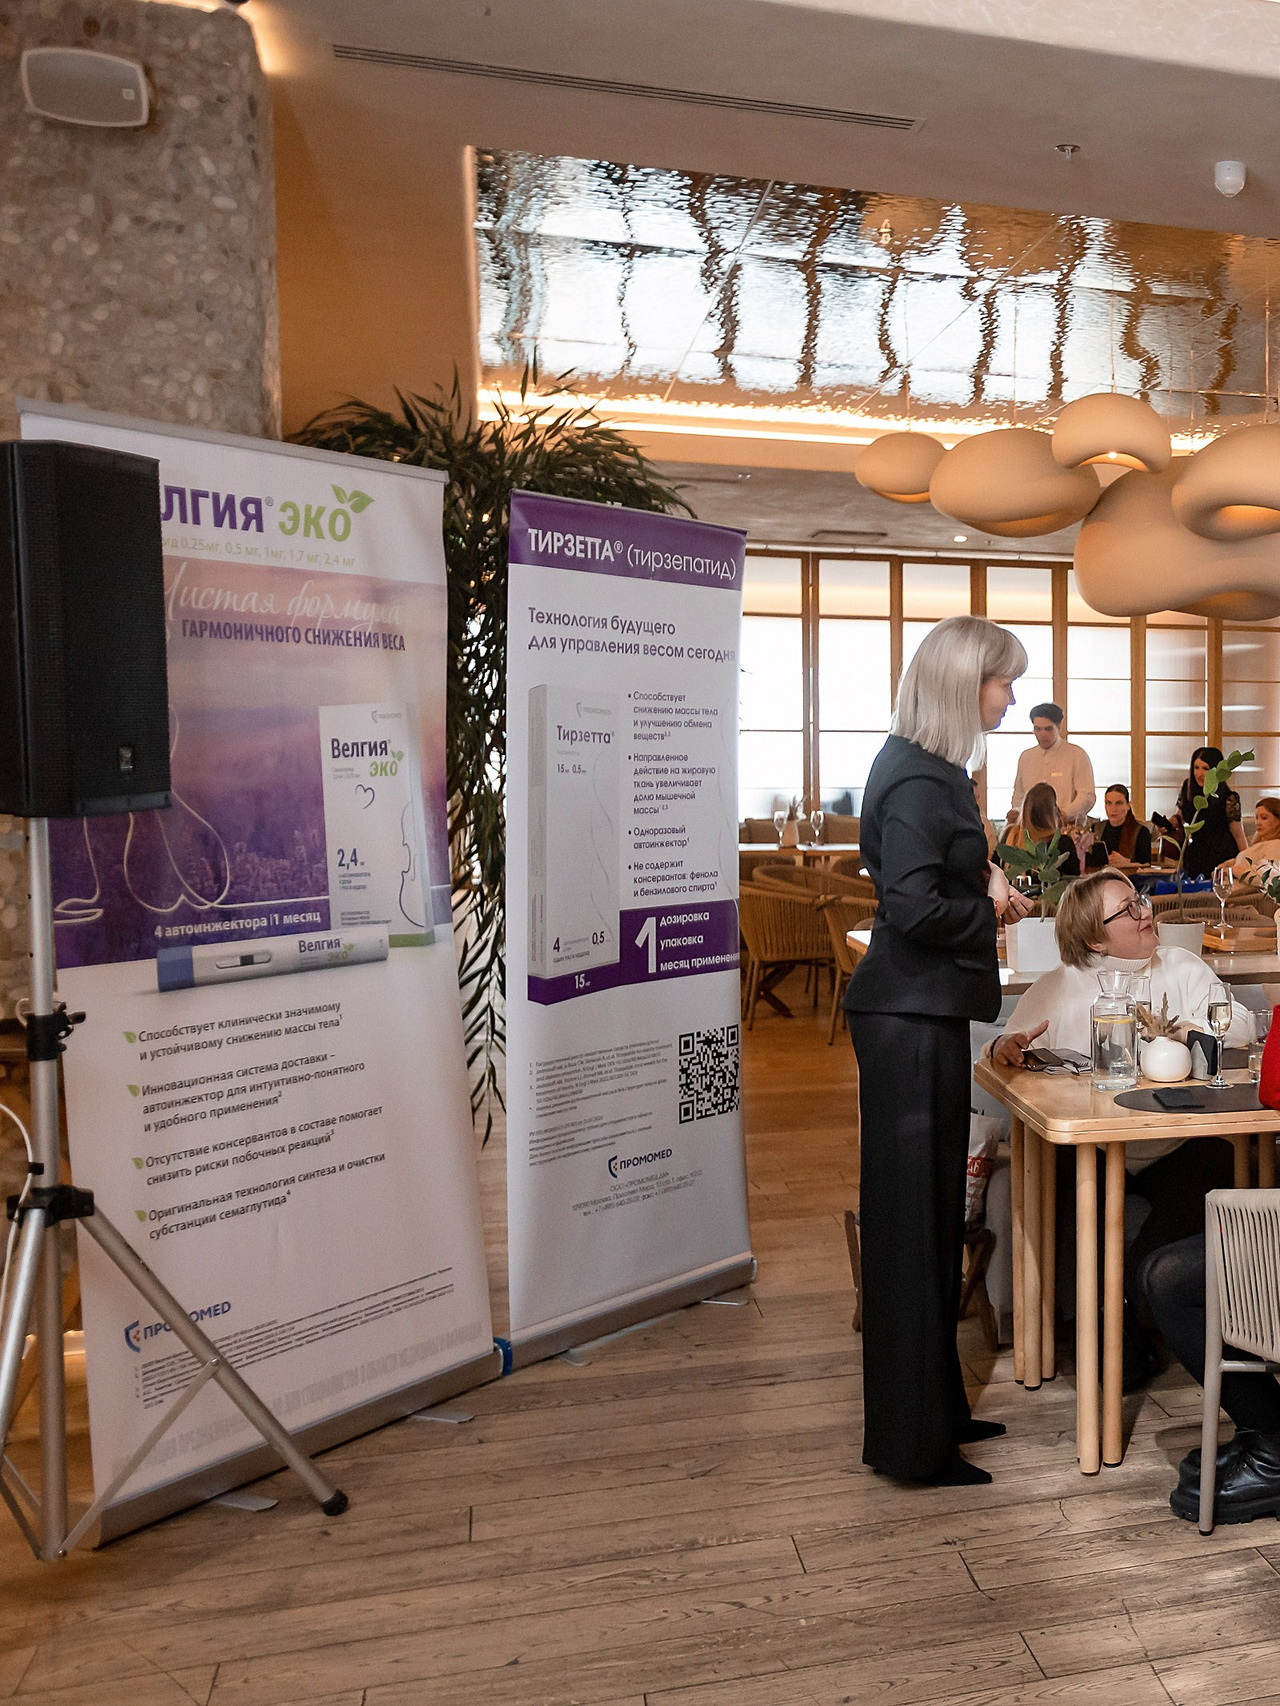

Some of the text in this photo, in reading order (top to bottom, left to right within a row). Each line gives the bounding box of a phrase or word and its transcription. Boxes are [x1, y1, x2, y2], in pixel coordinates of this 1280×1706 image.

[627, 543, 737, 580] (тирзепатид)
[528, 607, 676, 636] Технология будущего
[182, 619, 406, 651] ГАРМОНИЧНОГО СНИЖЕНИЯ ВЕСА
[528, 635, 557, 650] для
[560, 637, 640, 655] управления
[643, 643, 684, 659] весом
[633, 691, 686, 703] Способствует
[633, 706, 718, 716] снижению массы тела
[640, 719, 682, 729] улучшению
[683, 719, 712, 728] обмена
[633, 753, 689, 763] Направленное
[633, 766, 716, 776] действие на жировую
[633, 780, 702, 789] ткань увеличивает
[633, 791, 696, 803] долю мышечной
[633, 824, 686, 837] Одноразовый
[633, 860, 684, 871] Не содержит
[689, 870, 719, 883] фенола
[640, 886, 687, 897] бензилового
[154, 926, 163, 938] 4
[165, 918, 267, 938] автоинжектора
[282, 911, 321, 925] месяц
[659, 911, 710, 927] дозировка
[634, 916, 657, 974] 1
[660, 934, 704, 951] упаковка
[660, 952, 740, 972] месяц применени
[138, 1002, 341, 1042] Способствует клинически значимому
[139, 1052, 148, 1061] и
[150, 1038, 224, 1062] устойчивому
[226, 1029, 283, 1046] снижению
[284, 1023, 317, 1037] массы
[141, 1071, 234, 1097] Инновационная
[236, 1063, 279, 1079] система
[281, 1054, 328, 1072] доставки
[142, 1062, 366, 1115] автоинжектор для интуитивно-понятного
[143, 1122, 151, 1132] и
[153, 1111, 208, 1132] удобного
[145, 1106, 384, 1169] Отсутствие консервантов в составе помогает
[146, 1168, 192, 1186] снизить
[194, 1159, 229, 1176] риски
[232, 1145, 286, 1166] побочных
[148, 1153, 386, 1222] Оригинальная технология синтеза и очистки
[149, 1214, 217, 1240] субстанции
